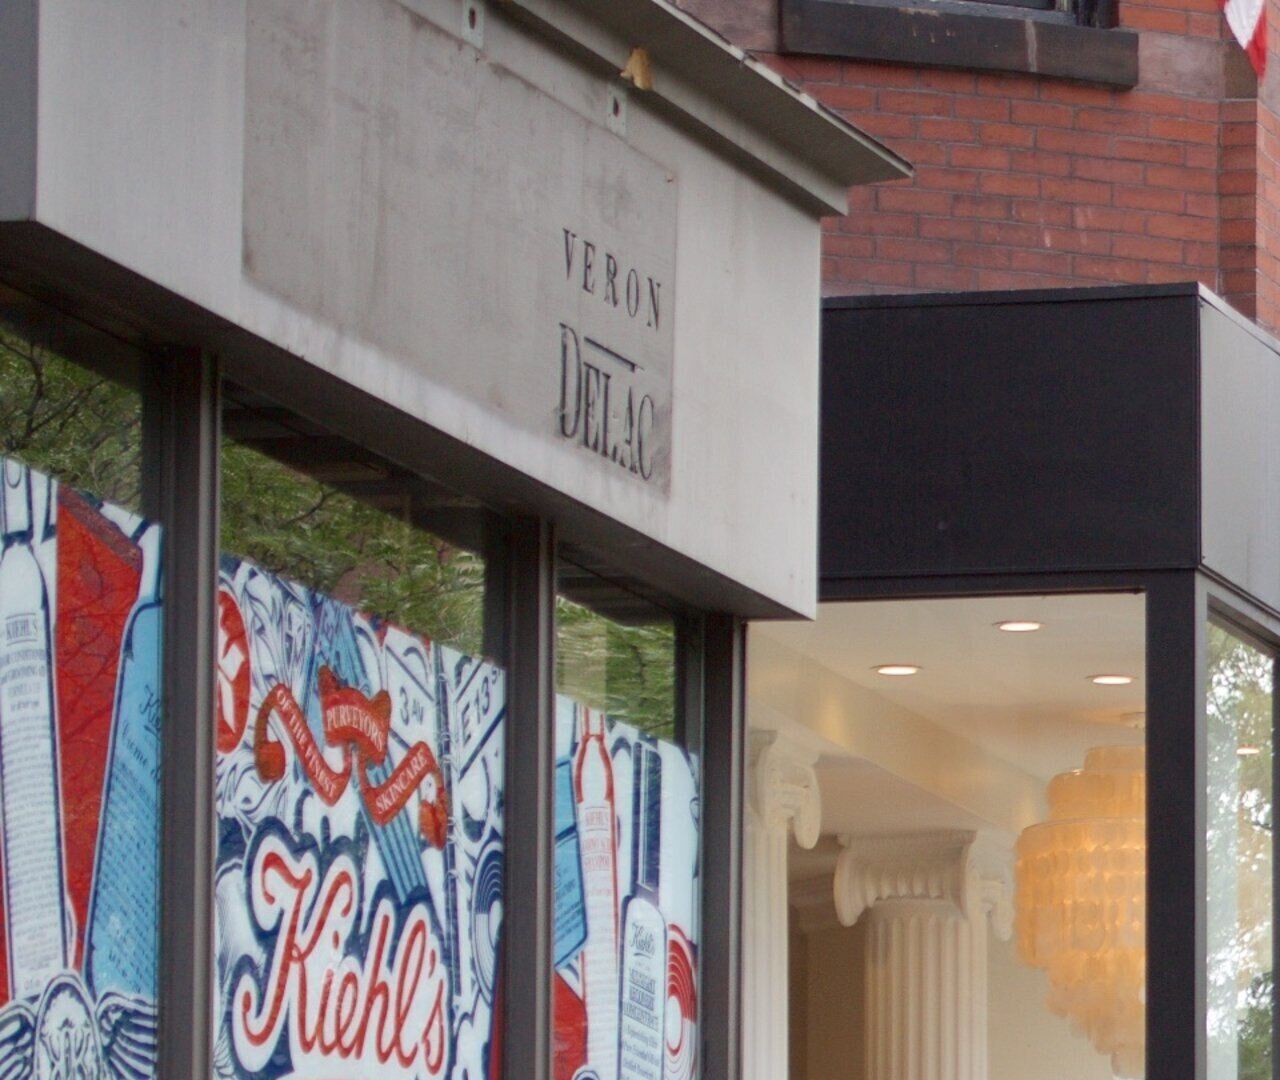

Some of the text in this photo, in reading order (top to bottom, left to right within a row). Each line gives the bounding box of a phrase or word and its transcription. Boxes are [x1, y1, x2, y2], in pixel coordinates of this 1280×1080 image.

[562, 227, 662, 331] VERON
[326, 704, 385, 753] PURVEYORS
[375, 750, 429, 815] SKINCARE
[241, 851, 445, 1076] Kiehl's
